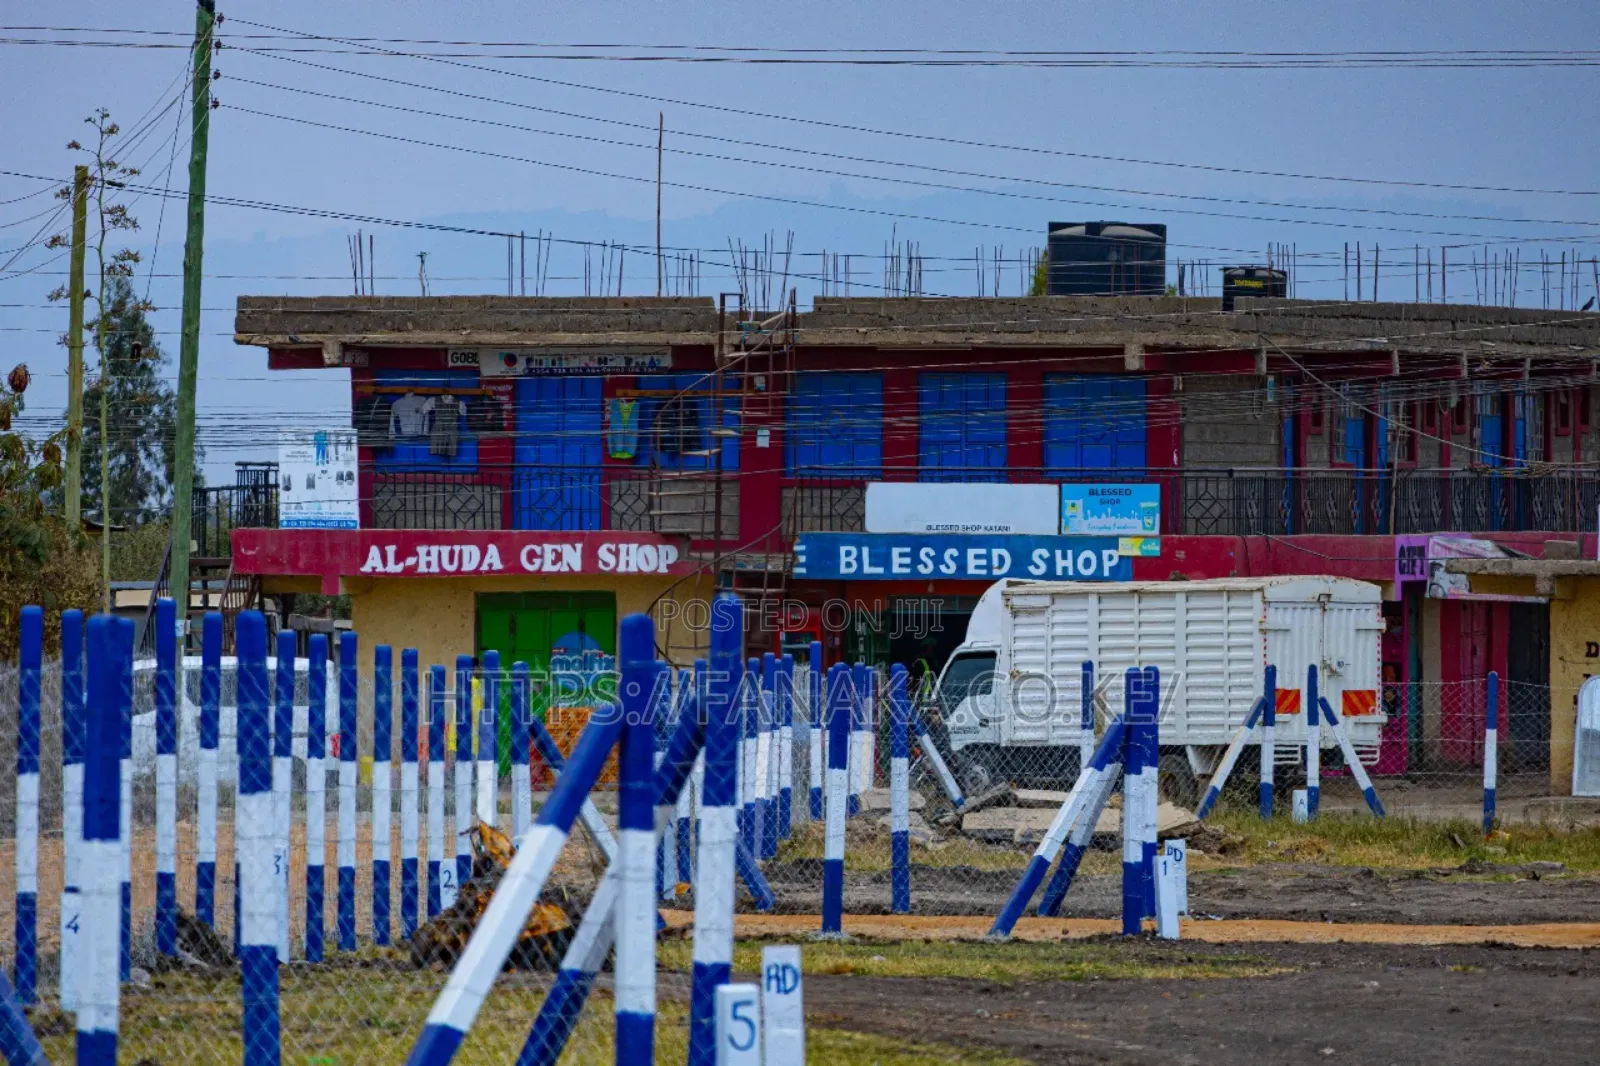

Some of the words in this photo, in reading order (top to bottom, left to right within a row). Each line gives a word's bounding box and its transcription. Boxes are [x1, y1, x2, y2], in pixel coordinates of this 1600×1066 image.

[1088, 488, 1132, 497] BLESSED
[1099, 498, 1121, 506] SHOP
[960, 524, 982, 532] SHOP
[360, 544, 504, 573] AL-HUDA
[519, 543, 583, 572] GEN
[597, 543, 679, 573] SHOP
[839, 545, 1012, 575] BLESSED
[1028, 548, 1119, 577] SHOP
[273, 854, 282, 875] 3
[443, 869, 456, 889] 2
[65, 913, 80, 935] 4
[727, 999, 757, 1052] 5
